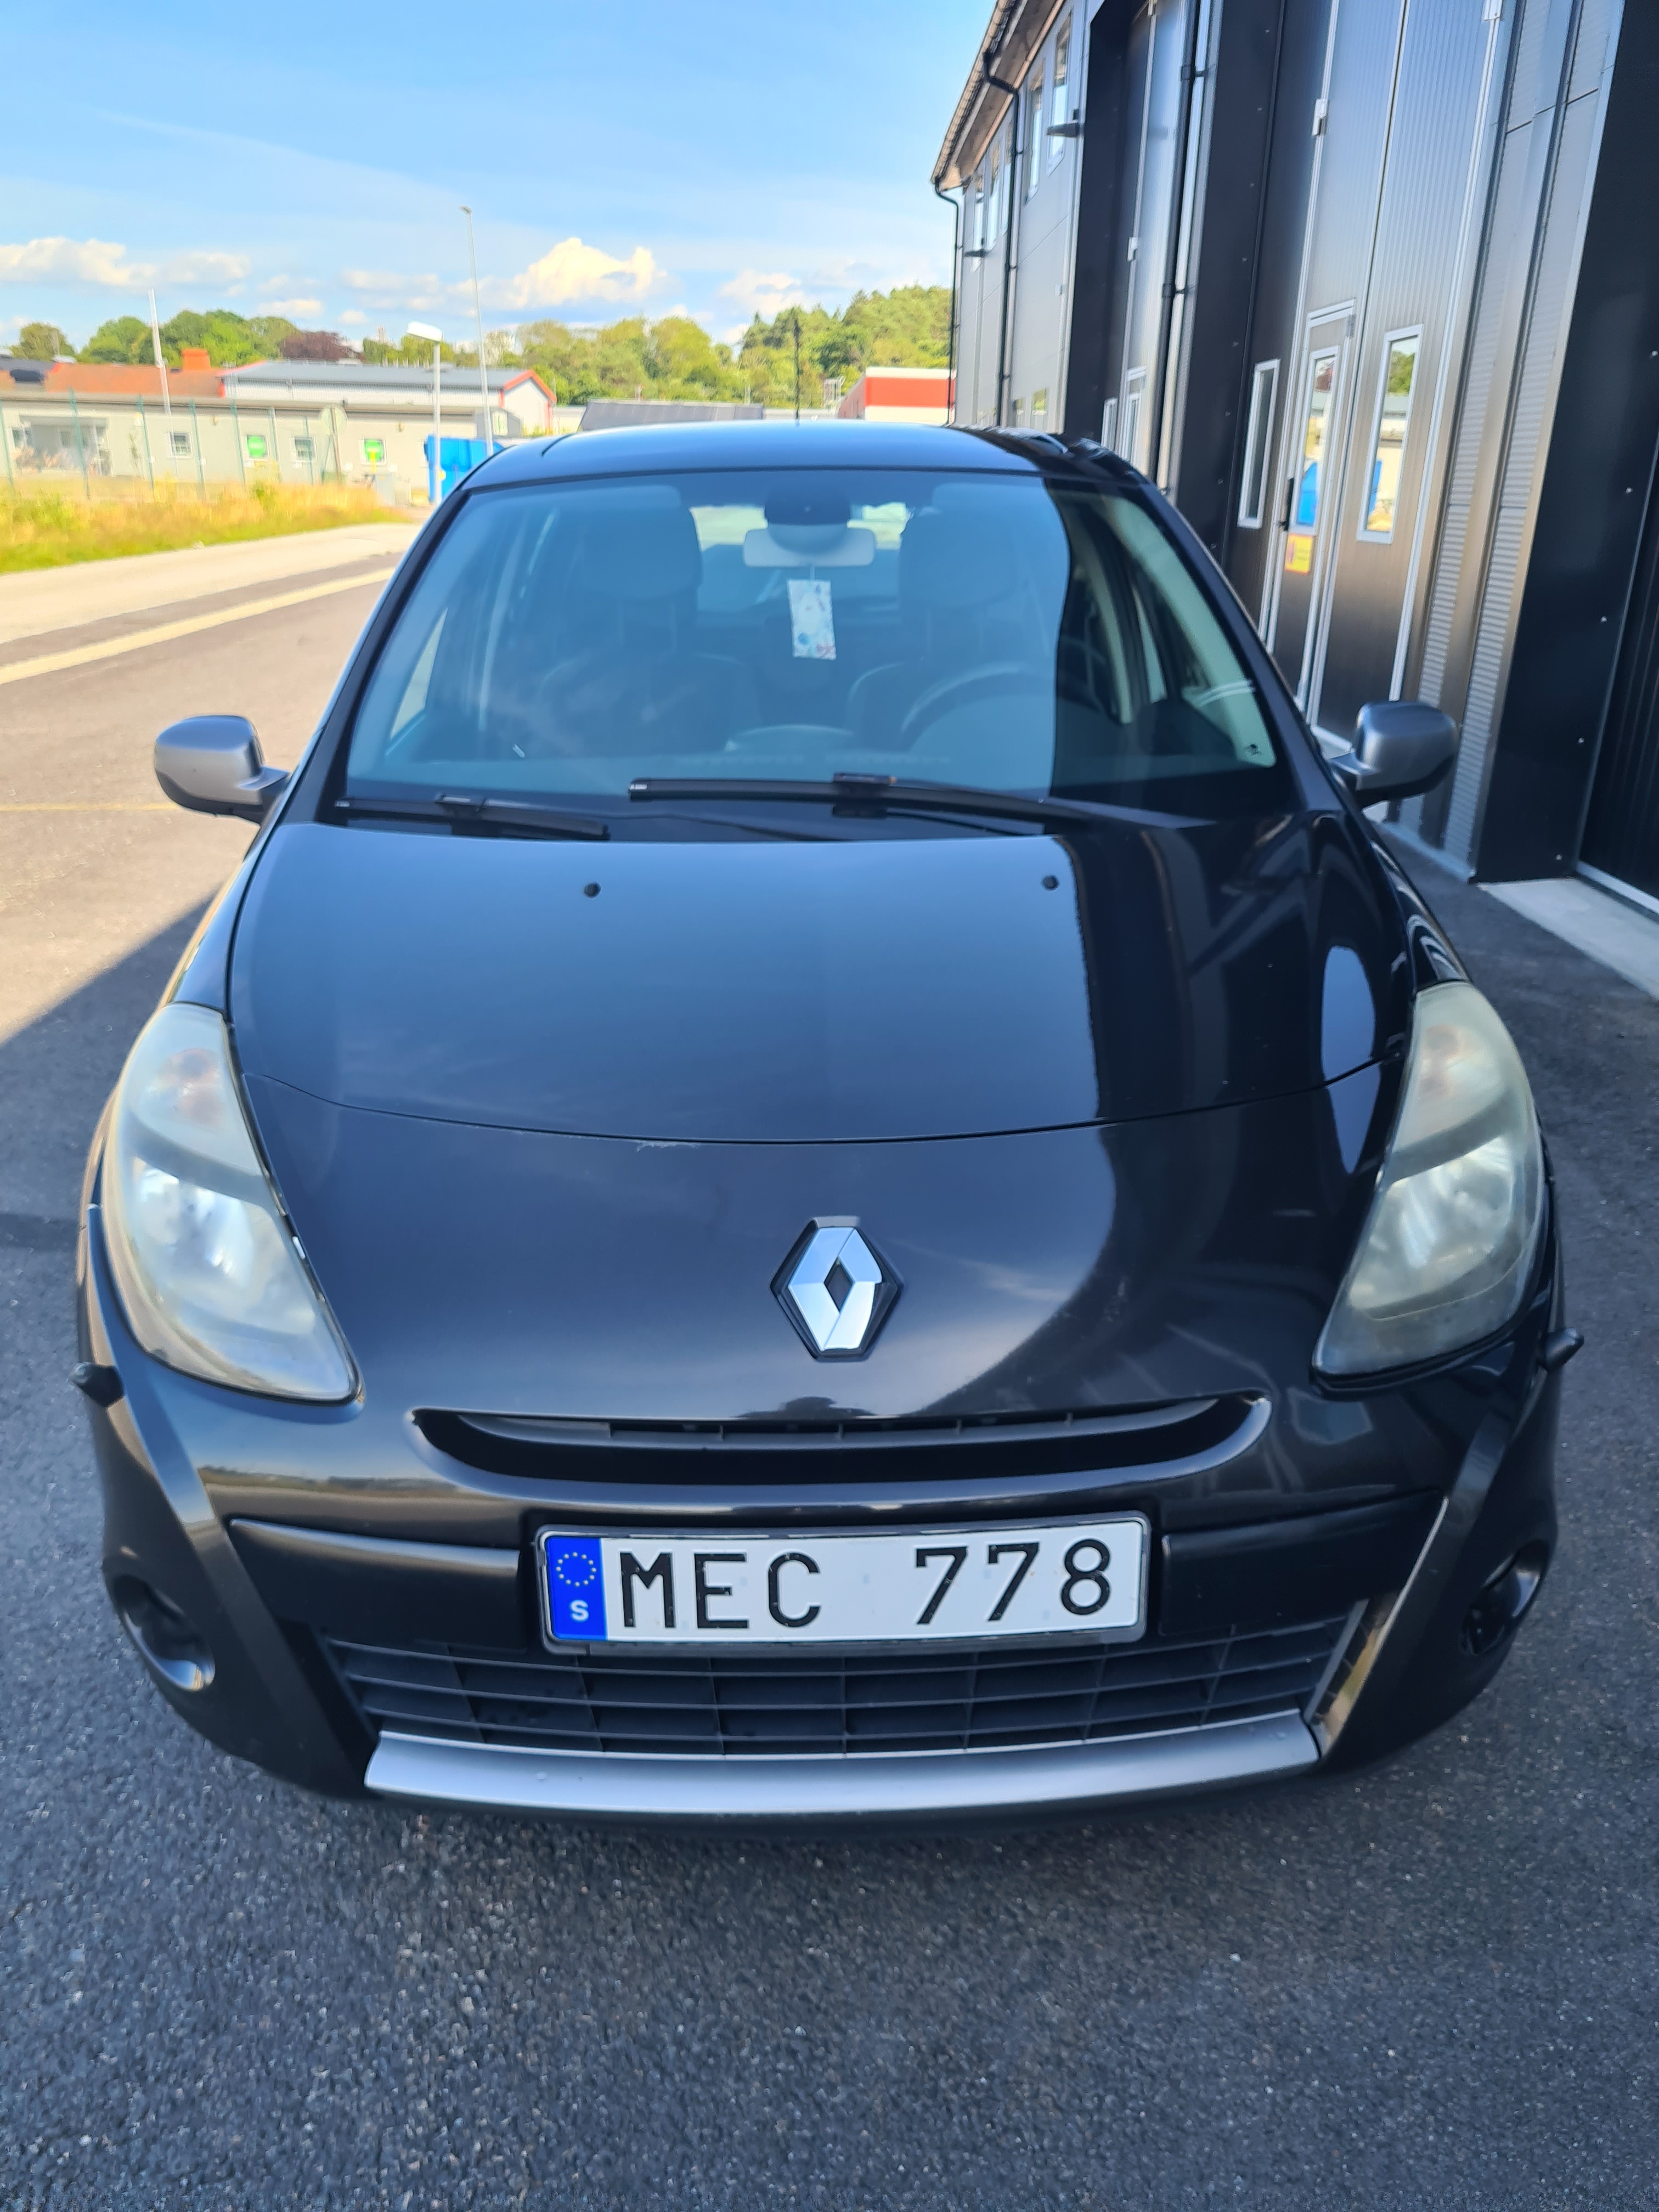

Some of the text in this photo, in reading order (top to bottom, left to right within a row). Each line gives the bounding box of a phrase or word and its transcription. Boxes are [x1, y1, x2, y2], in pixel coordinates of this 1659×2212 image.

[570, 1600, 590, 1622] S
[619, 1538, 1111, 1629] MEC 778
